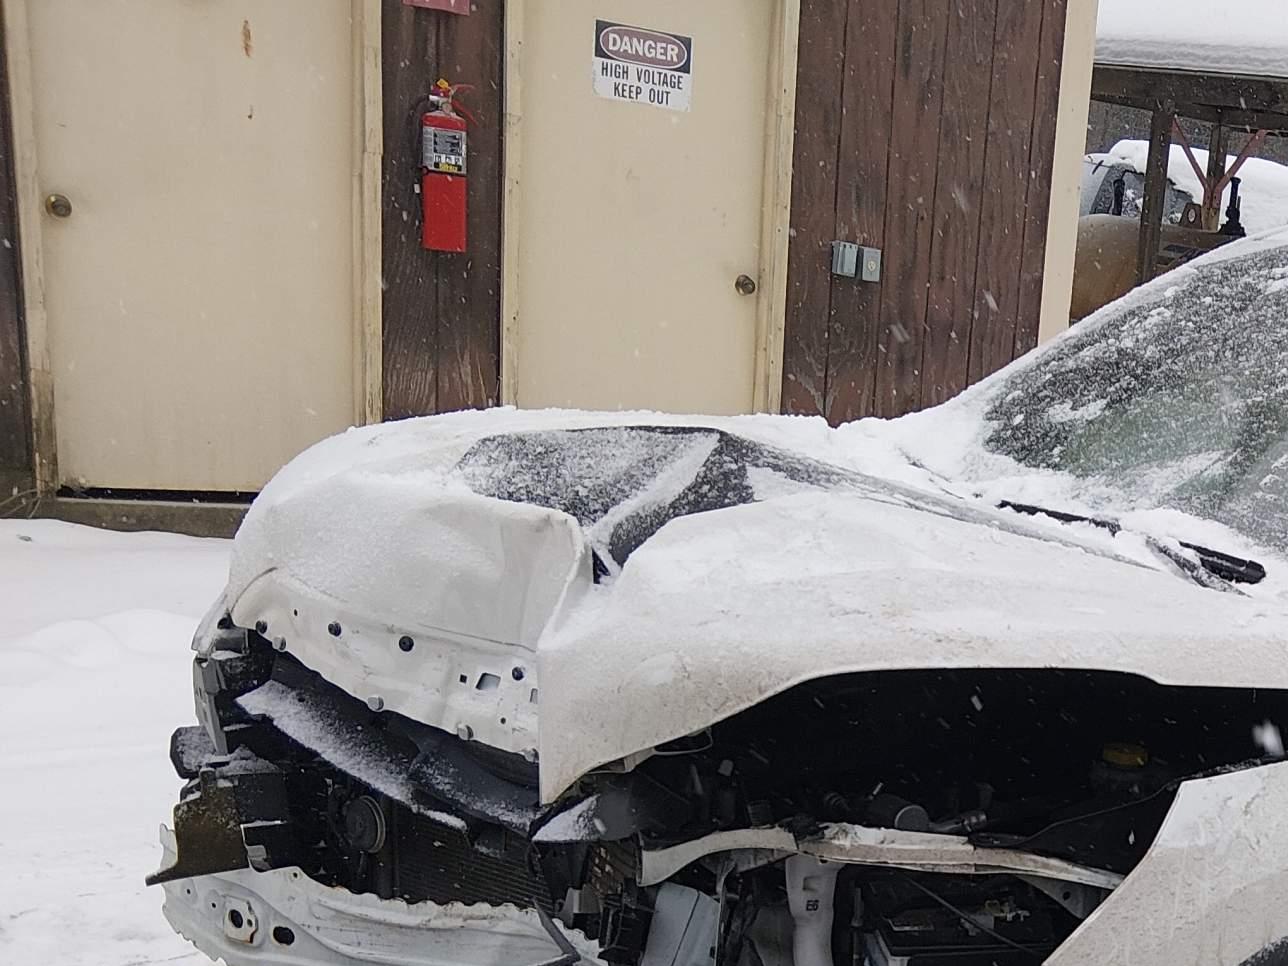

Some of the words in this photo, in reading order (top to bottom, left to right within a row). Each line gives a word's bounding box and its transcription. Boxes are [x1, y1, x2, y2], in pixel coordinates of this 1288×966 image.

[608, 33, 679, 62] DANGER
[601, 61, 629, 80] HIGH
[636, 67, 683, 90] VOLTAGE
[613, 82, 642, 100] KEEP
[649, 88, 671, 105] OUT
